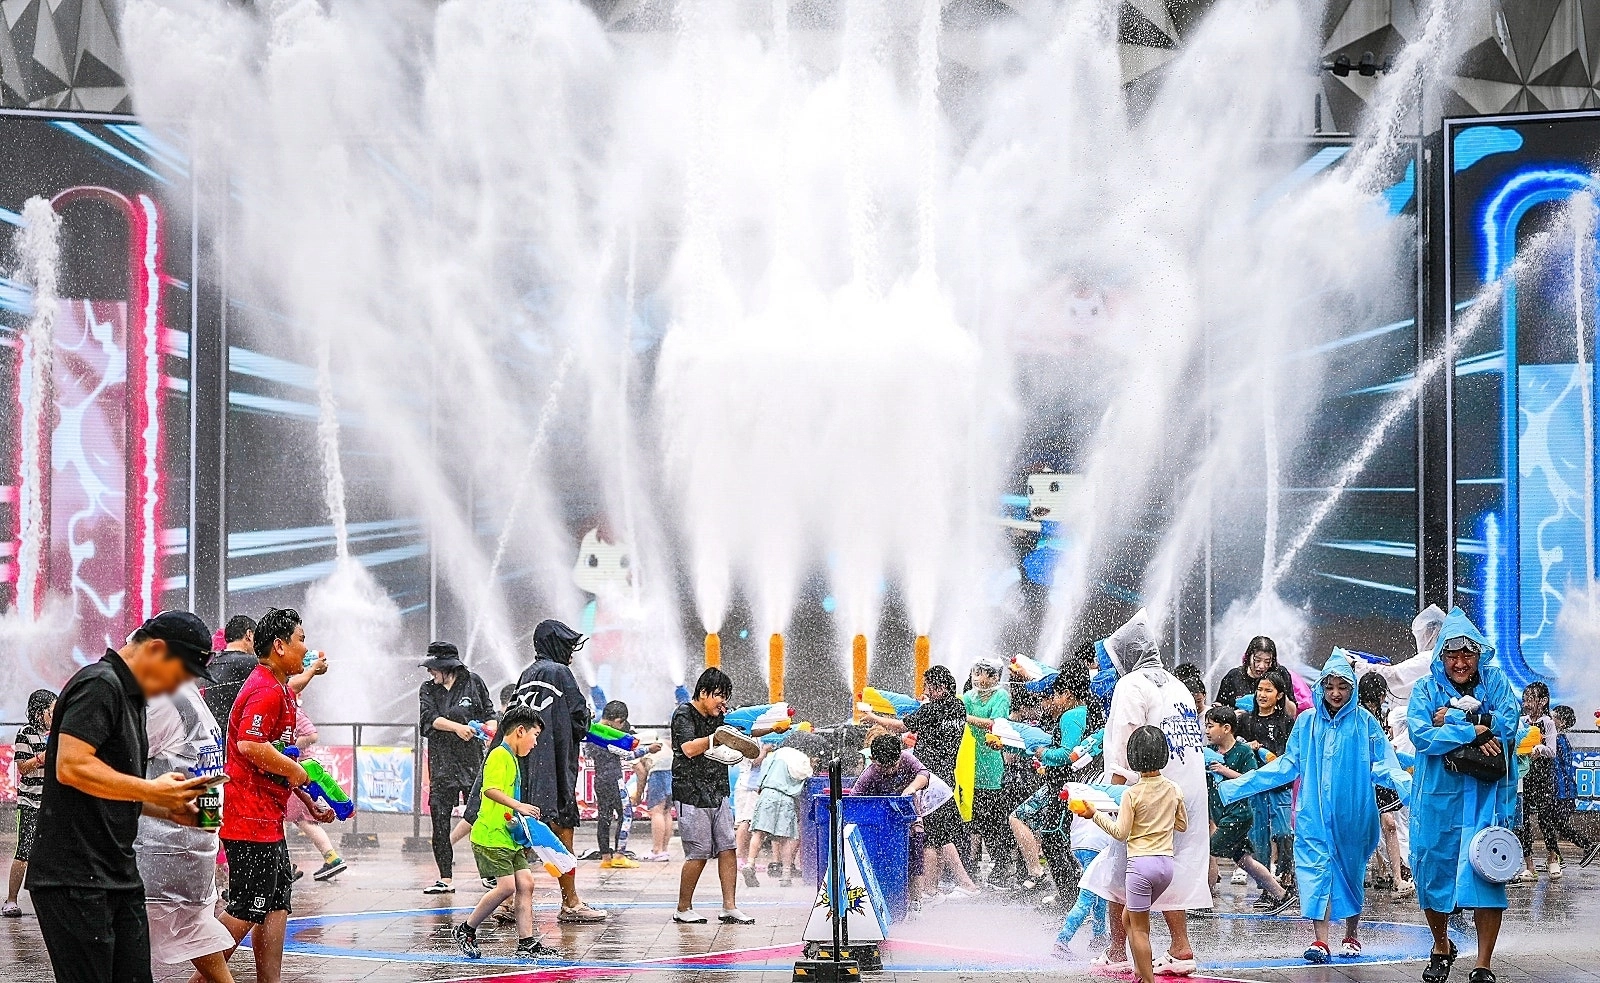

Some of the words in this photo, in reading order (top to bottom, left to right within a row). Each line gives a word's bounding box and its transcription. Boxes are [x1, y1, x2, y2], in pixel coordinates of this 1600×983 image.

[1160, 721, 1201, 734] WATER
[1172, 733, 1203, 747] WARS
[198, 797, 219, 807] TERR
